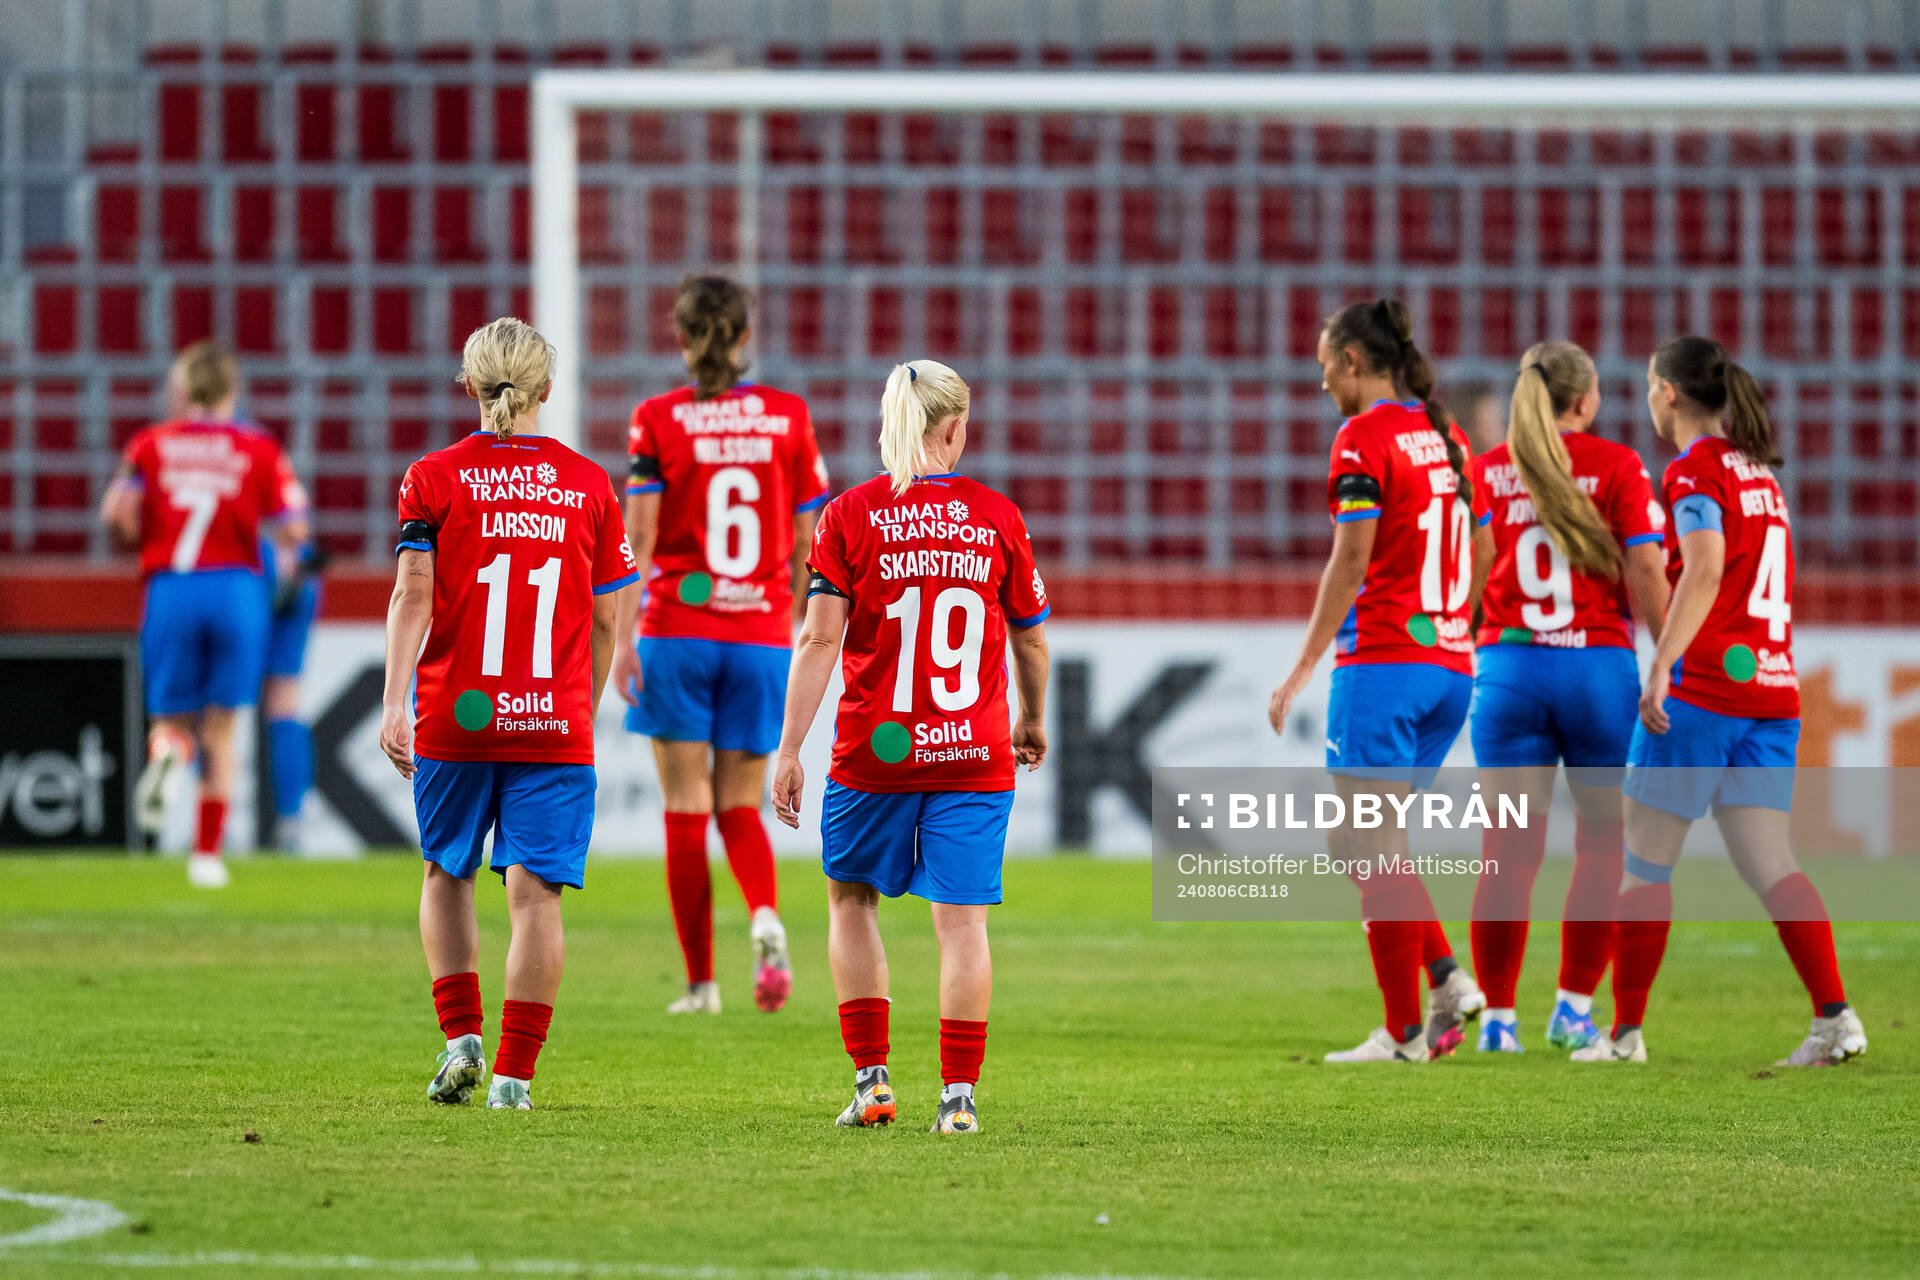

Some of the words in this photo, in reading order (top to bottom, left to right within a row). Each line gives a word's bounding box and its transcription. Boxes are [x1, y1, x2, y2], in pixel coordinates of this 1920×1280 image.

[459, 466, 534, 484] KLIMAT
[469, 482, 587, 510] TRANSPORT
[482, 512, 565, 542] LARSSON
[705, 467, 760, 578] 6
[869, 504, 943, 527] KLIMAT
[170, 491, 220, 572] 7
[880, 522, 996, 547] TRANSPORT
[879, 549, 991, 582] SKARSTRÖM
[1417, 496, 1471, 612] 10
[1516, 525, 1575, 632] 9
[1748, 525, 1791, 642] 4
[477, 554, 561, 678] 11
[886, 587, 985, 712] 19
[497, 692, 553, 713] Solid
[497, 717, 568, 734] Försäkring
[914, 721, 972, 746] Solid
[914, 745, 990, 763] Försäkring
[1054, 658, 1222, 856] K
